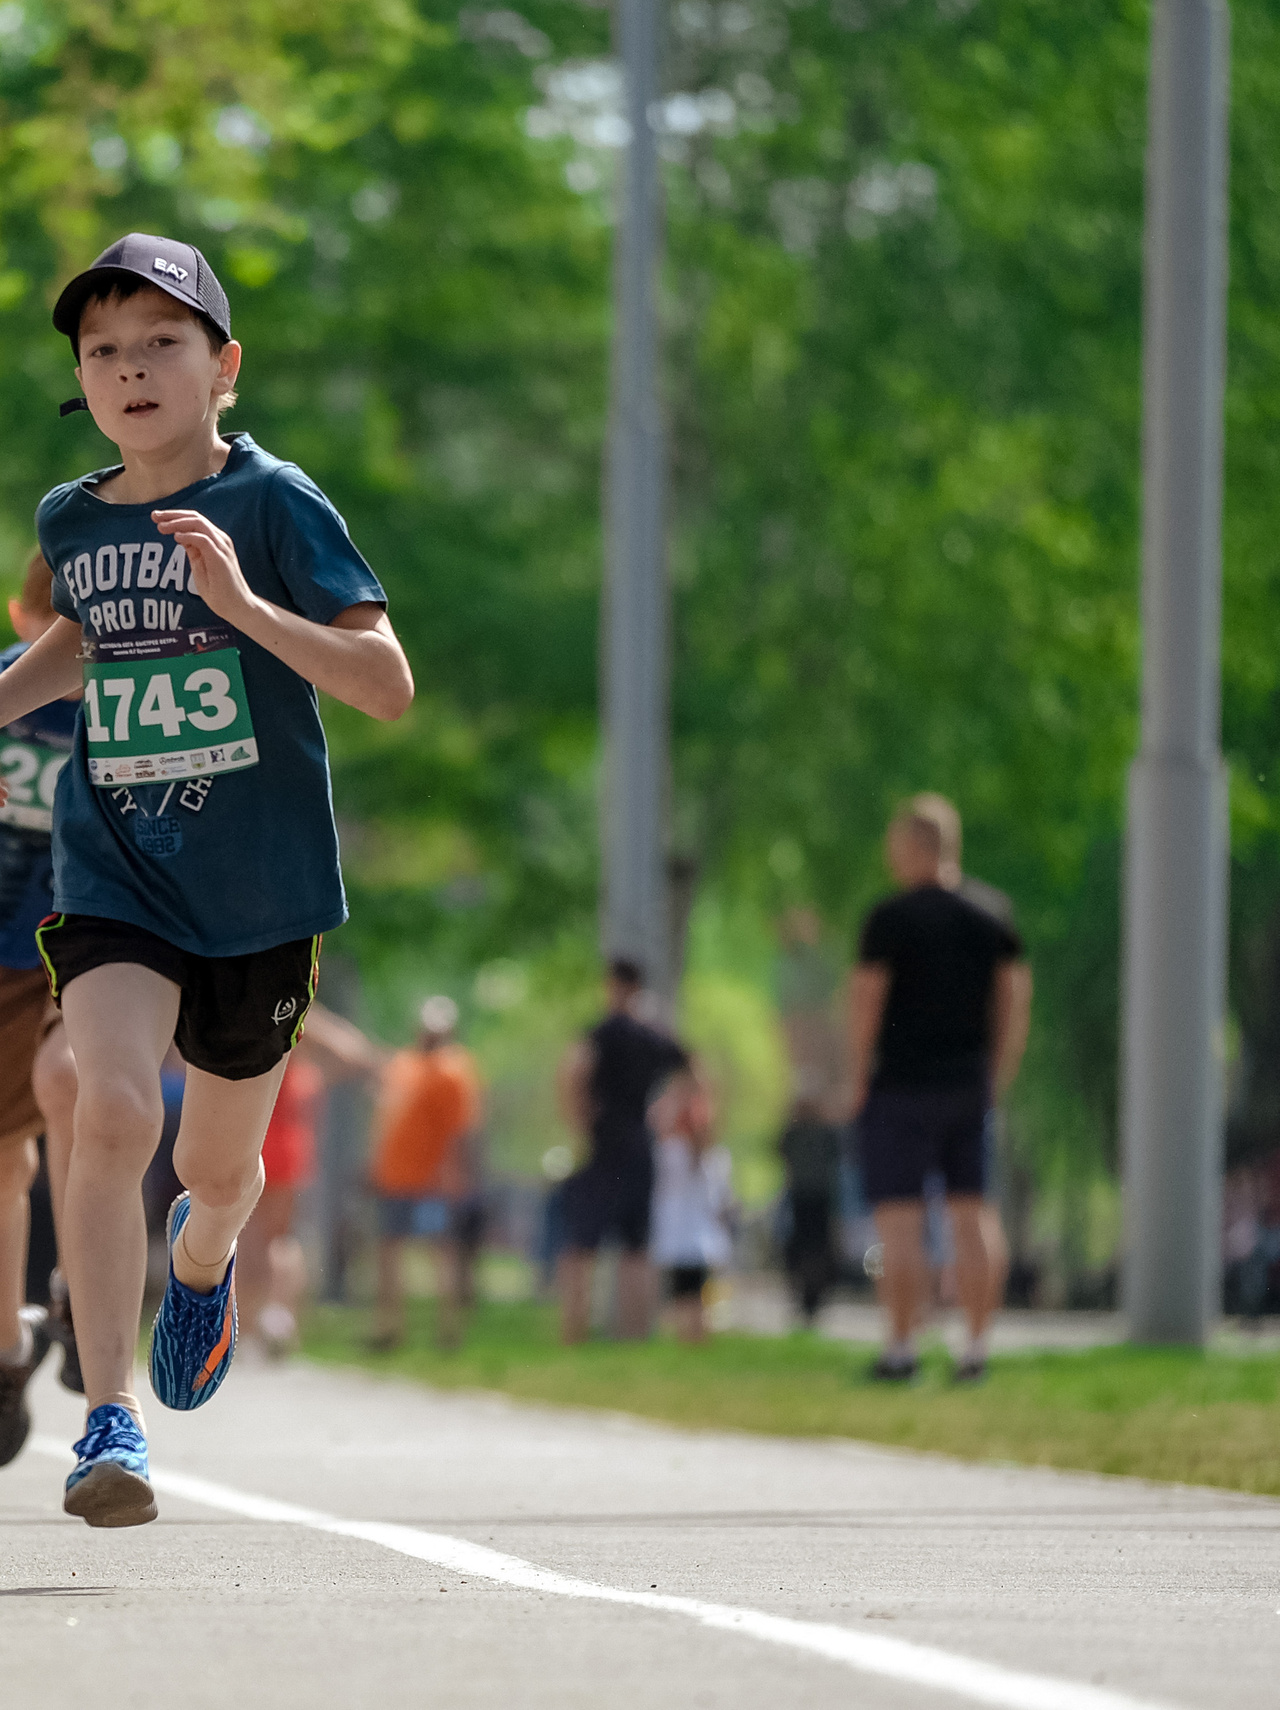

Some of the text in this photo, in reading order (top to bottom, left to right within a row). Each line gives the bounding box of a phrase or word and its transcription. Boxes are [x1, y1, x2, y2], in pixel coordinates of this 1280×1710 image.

[154, 257, 189, 281] EA7
[62, 541, 199, 609] FOOTBA
[88, 597, 184, 637] PRO DIV.
[84, 667, 238, 743] 1743
